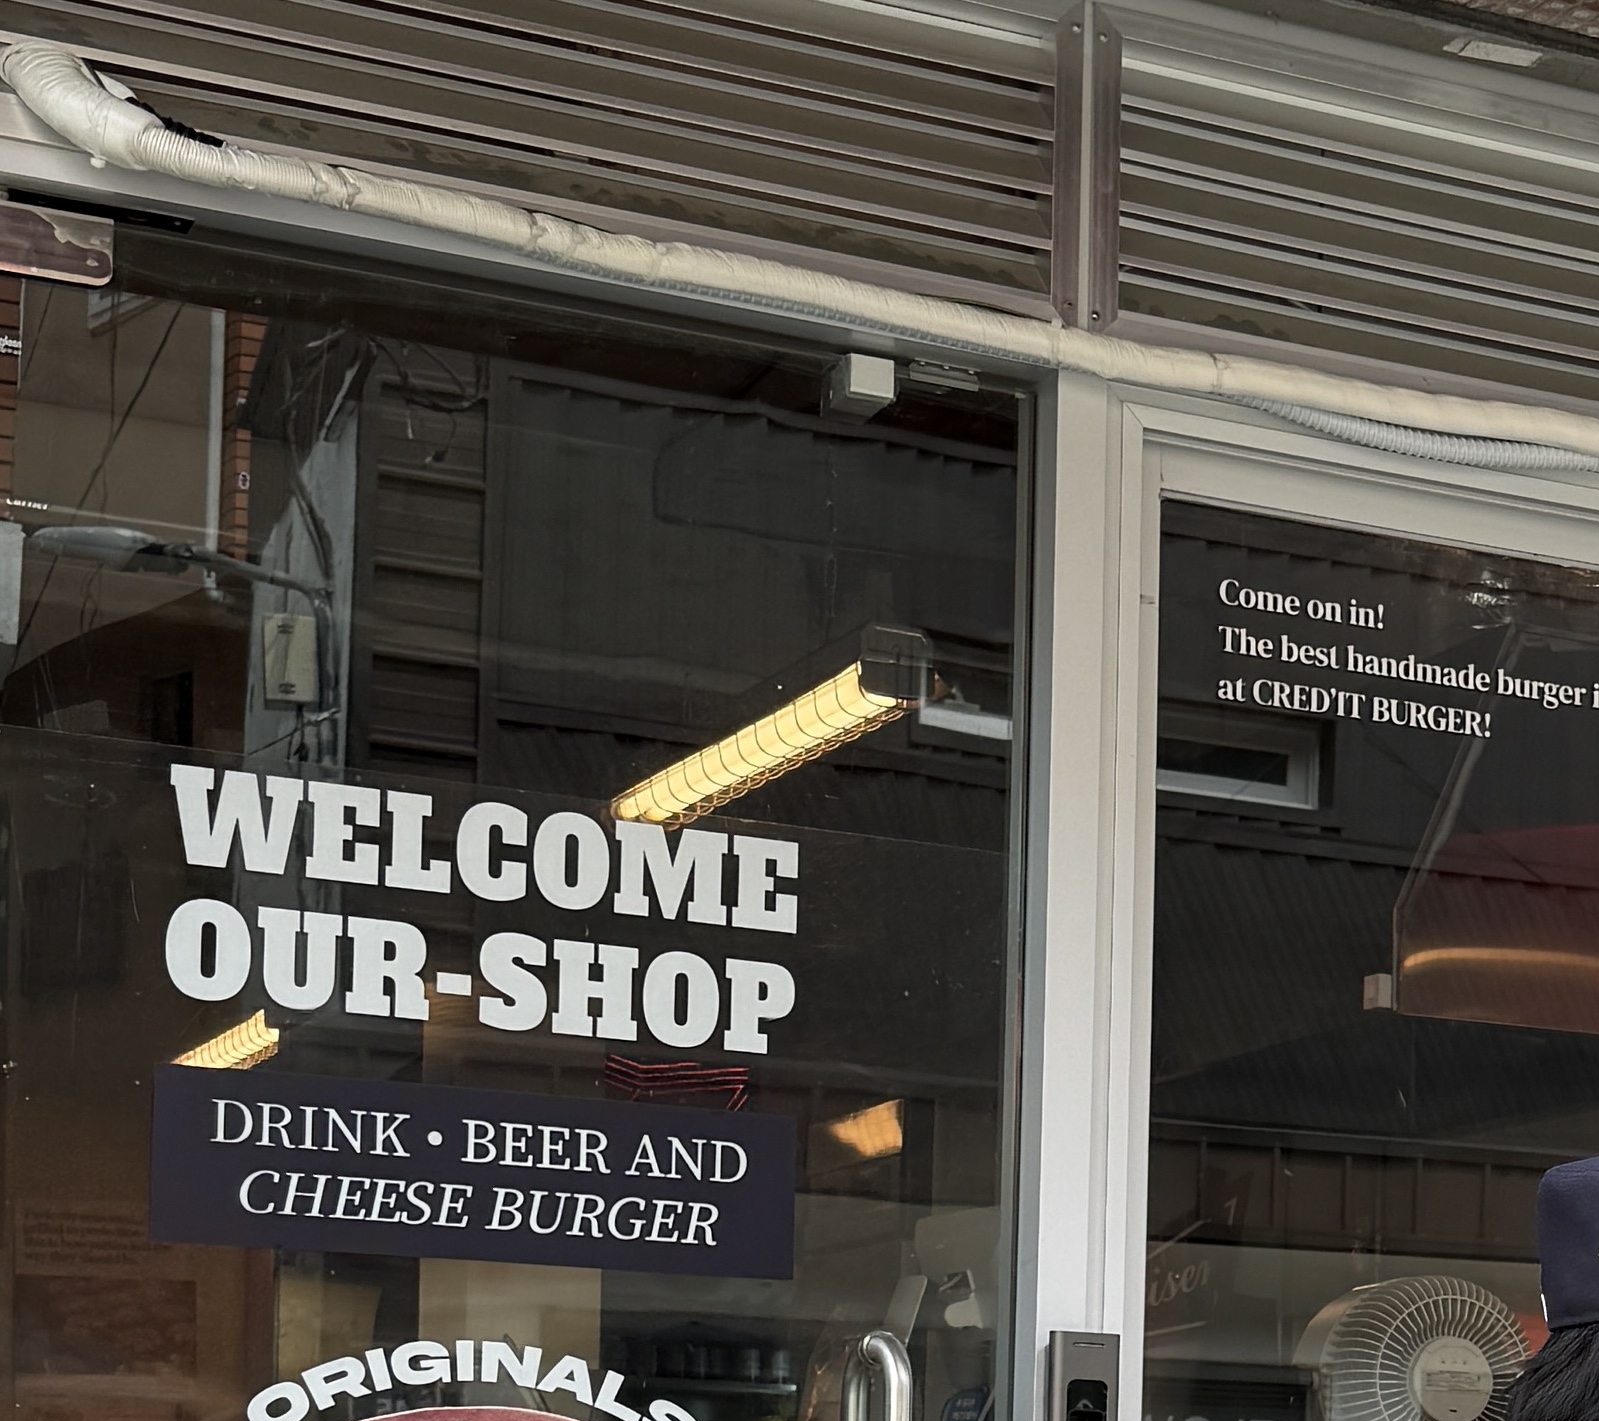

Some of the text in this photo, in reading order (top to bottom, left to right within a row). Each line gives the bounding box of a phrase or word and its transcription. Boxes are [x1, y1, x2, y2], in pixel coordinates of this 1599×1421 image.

[1219, 578, 1384, 629] Come on in!
[1217, 677, 1492, 738] at CRED'IT BURGER!
[1218, 625, 1274, 658] The
[1281, 634, 1339, 670] best
[1347, 644, 1491, 692] handmade
[1497, 668, 1587, 710] burger
[170, 762, 799, 935] WELCOME
[164, 898, 796, 1056] OUR-SHOP
[210, 1097, 749, 1185] DRINK BEER AND
[238, 1169, 720, 1247] CHEESE BURGER
